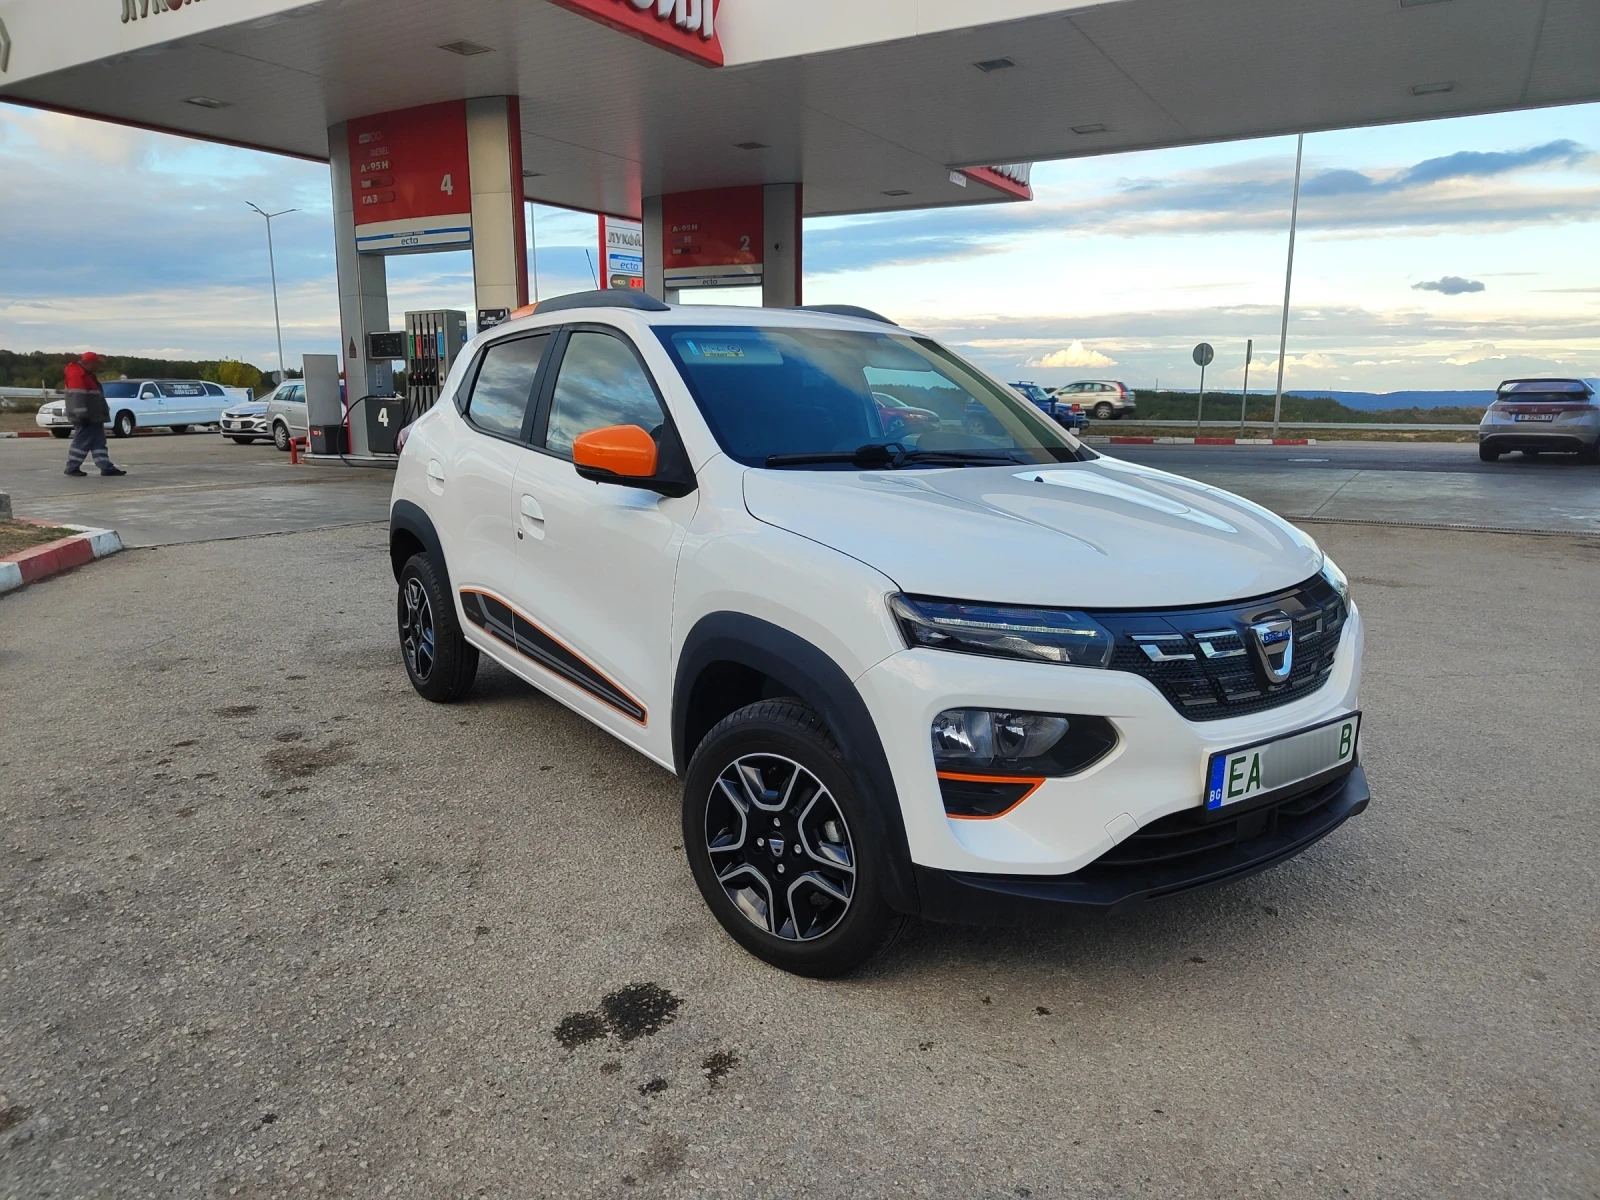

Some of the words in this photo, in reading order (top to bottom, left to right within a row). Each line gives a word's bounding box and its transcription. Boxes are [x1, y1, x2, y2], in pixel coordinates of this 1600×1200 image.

[441, 174, 453, 195] 4
[362, 194, 378, 204] ГАЗ
[400, 237, 419, 245] ecto
[740, 235, 751, 251] 2
[620, 261, 639, 271] ecto
[378, 408, 389, 427] 4
[1209, 790, 1221, 803] BG
